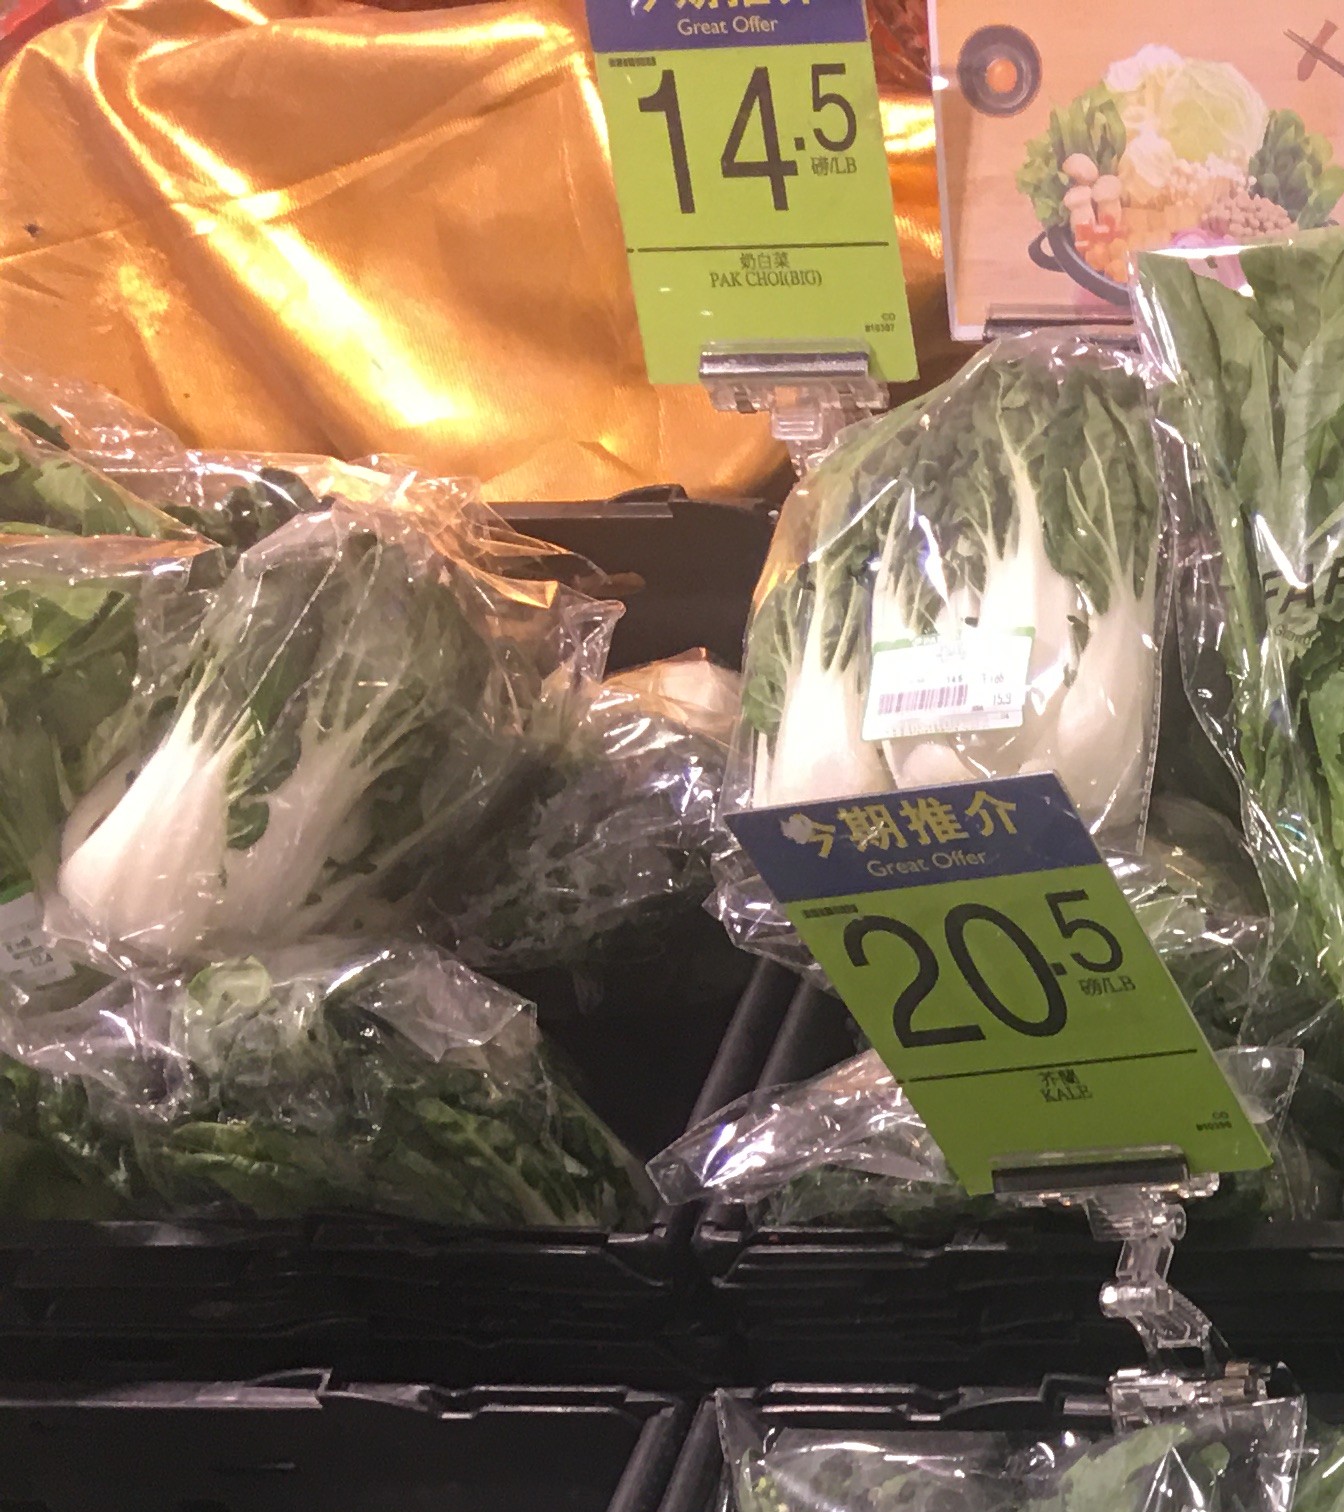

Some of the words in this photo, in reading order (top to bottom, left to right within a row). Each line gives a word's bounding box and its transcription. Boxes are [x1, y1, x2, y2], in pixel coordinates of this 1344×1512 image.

[677, 18, 728, 35] Great
[733, 16, 778, 33] Offer
[638, 63, 857, 214] 14.5
[709, 271, 742, 288] PAK
[745, 269, 822, 287] CHOI(BIG)
[780, 791, 1017, 858] 今期推介
[867, 858, 930, 878] Great
[932, 850, 986, 869] Offer
[843, 890, 1124, 1049] 20.5
[1040, 1084, 1093, 1103] KALE
